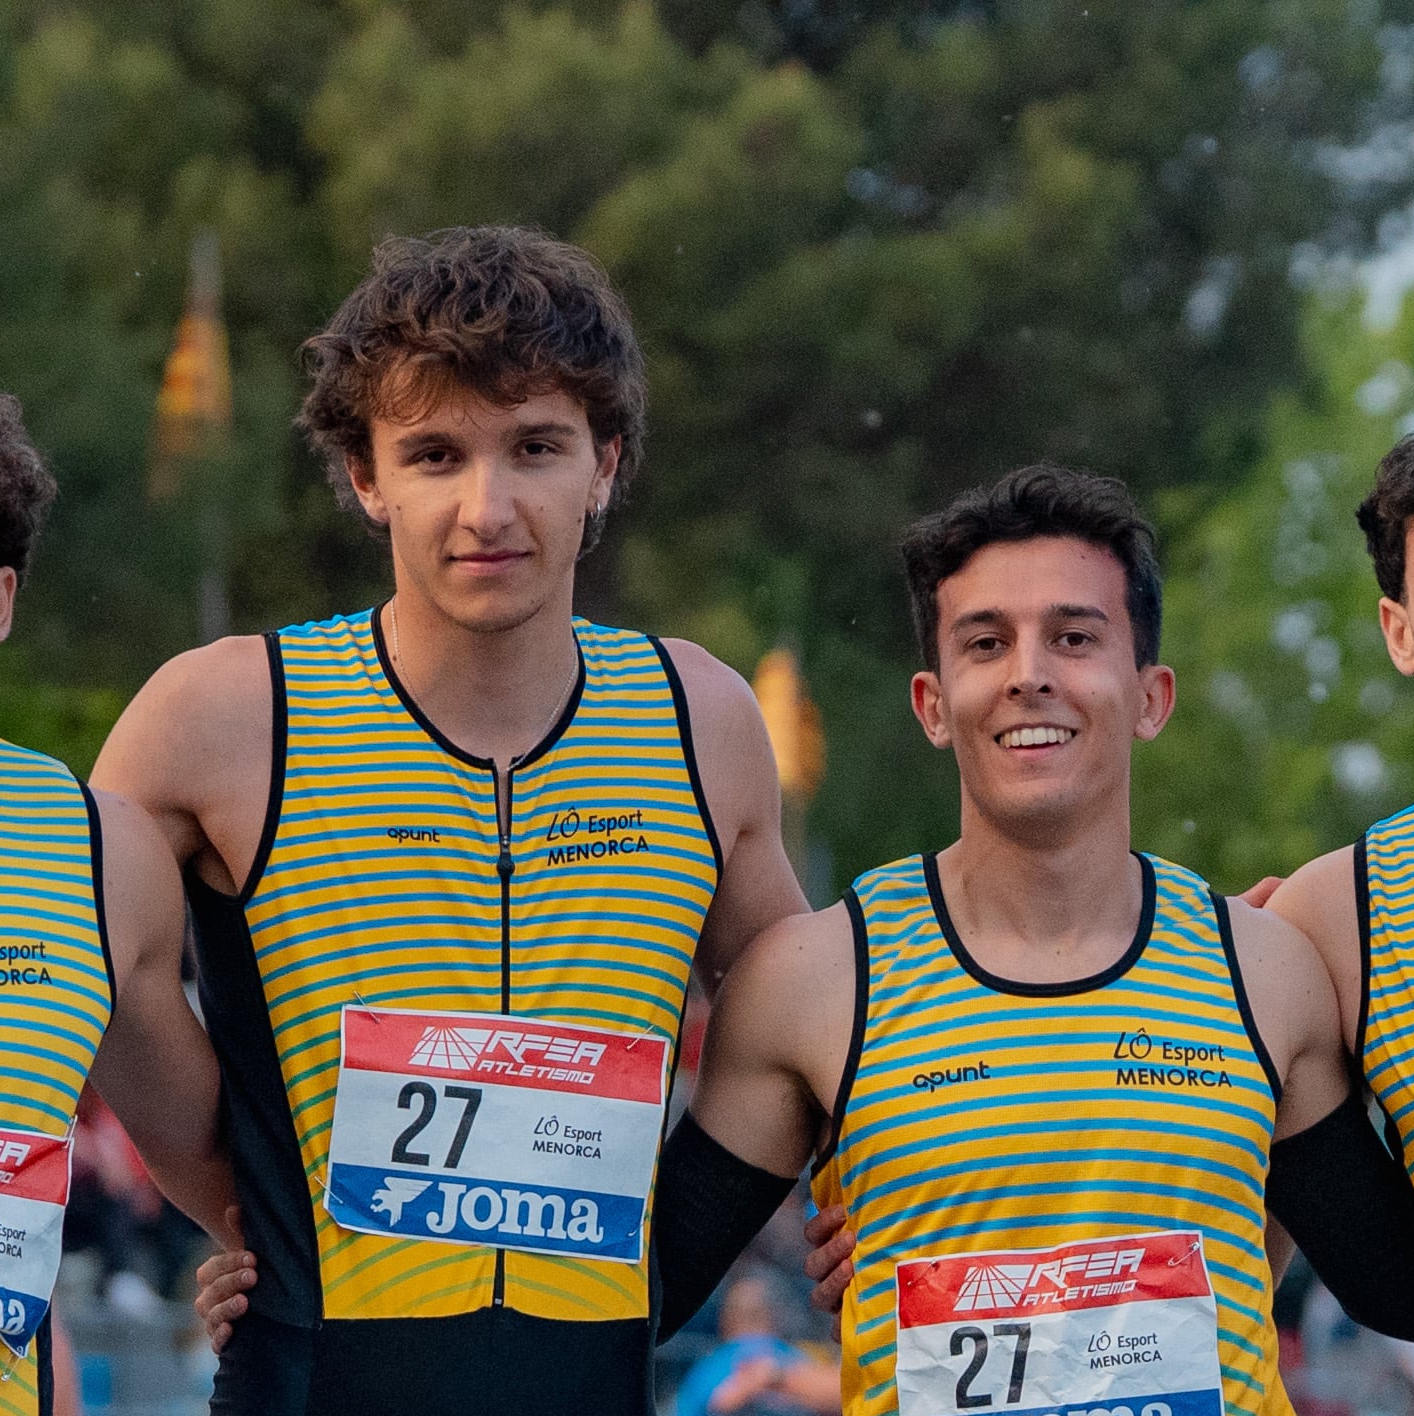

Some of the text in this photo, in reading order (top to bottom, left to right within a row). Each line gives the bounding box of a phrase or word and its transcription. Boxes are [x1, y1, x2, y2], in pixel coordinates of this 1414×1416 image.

[588, 809, 644, 835] Esport
[387, 826, 440, 844] apunt
[546, 835, 650, 867] MENORCA
[487, 1029, 607, 1066] RFEA
[1162, 1041, 1225, 1066] Esport
[477, 1061, 595, 1085] ATLETISMO
[913, 1061, 991, 1093] apunt
[1115, 1067, 1232, 1088] MENORCA
[390, 1081, 483, 1169] 27
[564, 1125, 602, 1143] Esport
[532, 1138, 602, 1159] MENORCA
[1028, 1247, 1146, 1292] RFEA
[1022, 1278, 1137, 1306] ATLETISMO
[1117, 1333, 1158, 1351] Esport
[950, 1322, 1032, 1410] 27
[1089, 1349, 1163, 1370] MENORCA
